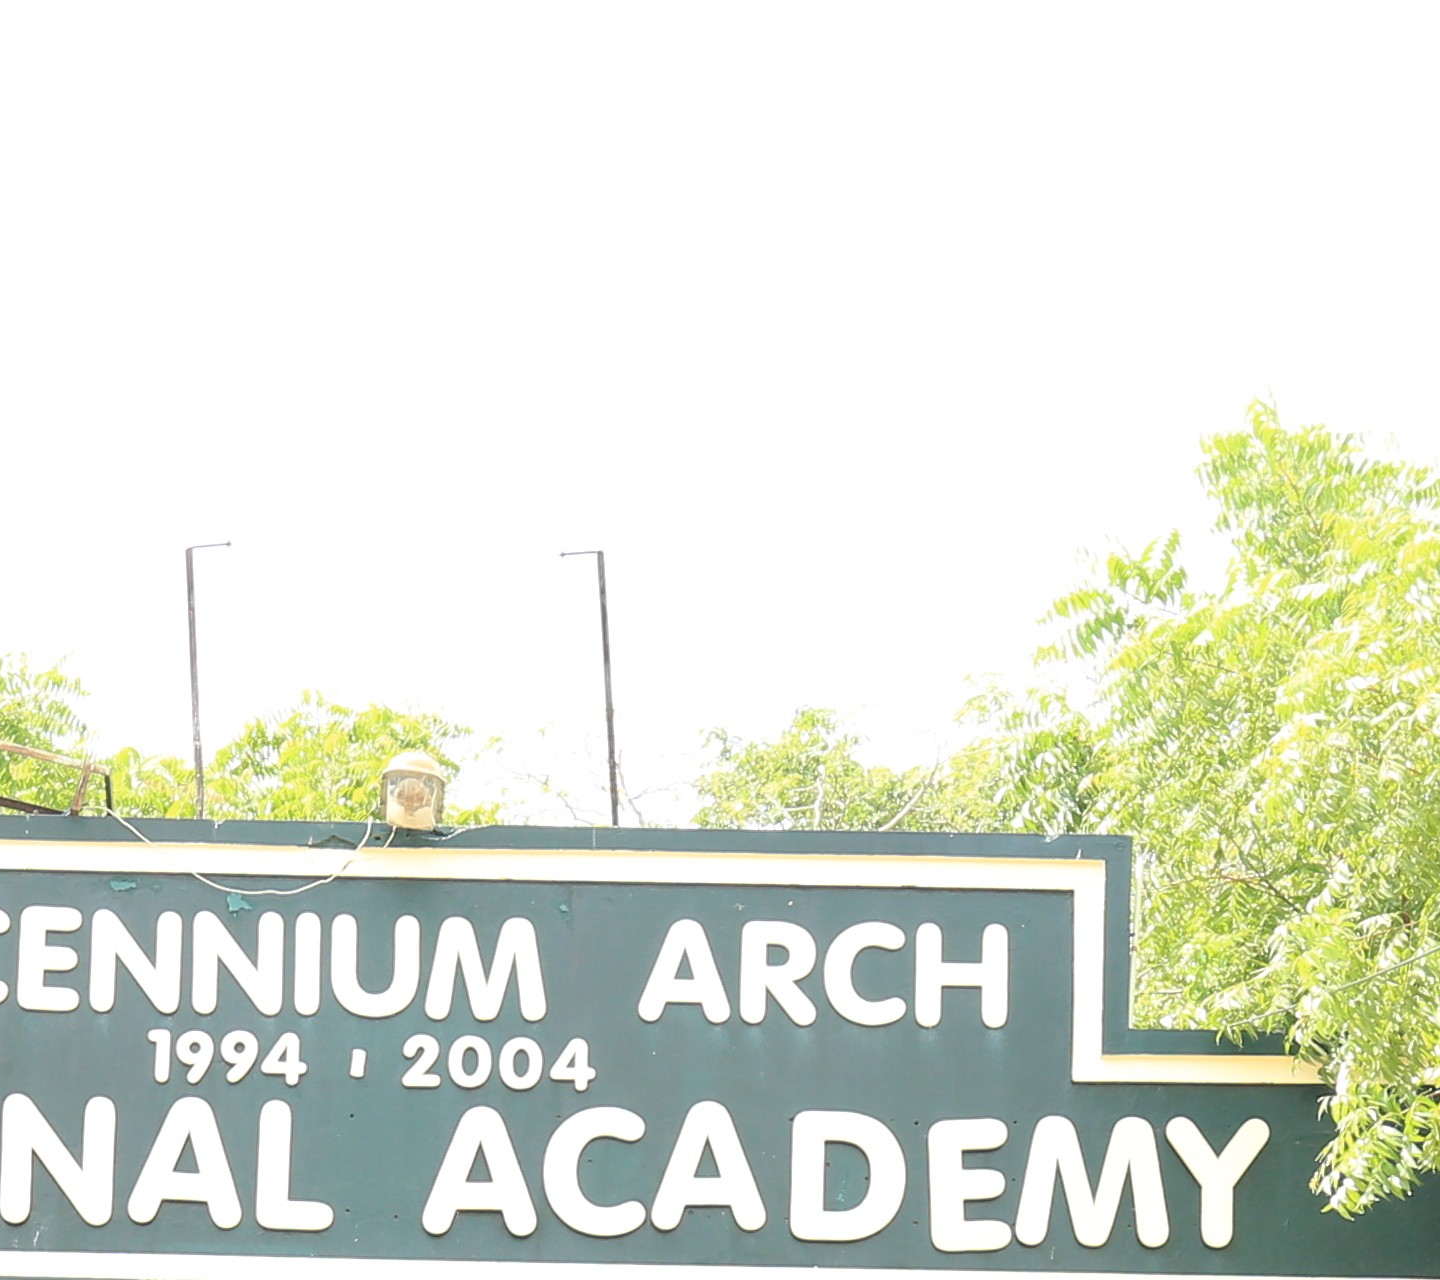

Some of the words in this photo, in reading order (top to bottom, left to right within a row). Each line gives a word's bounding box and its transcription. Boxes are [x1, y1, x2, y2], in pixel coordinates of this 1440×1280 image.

[639, 917, 1010, 1029] ARCH
[149, 1029, 306, 1085] 1994
[403, 1034, 595, 1093] 2004
[421, 1100, 1271, 1252] ACADEMY
